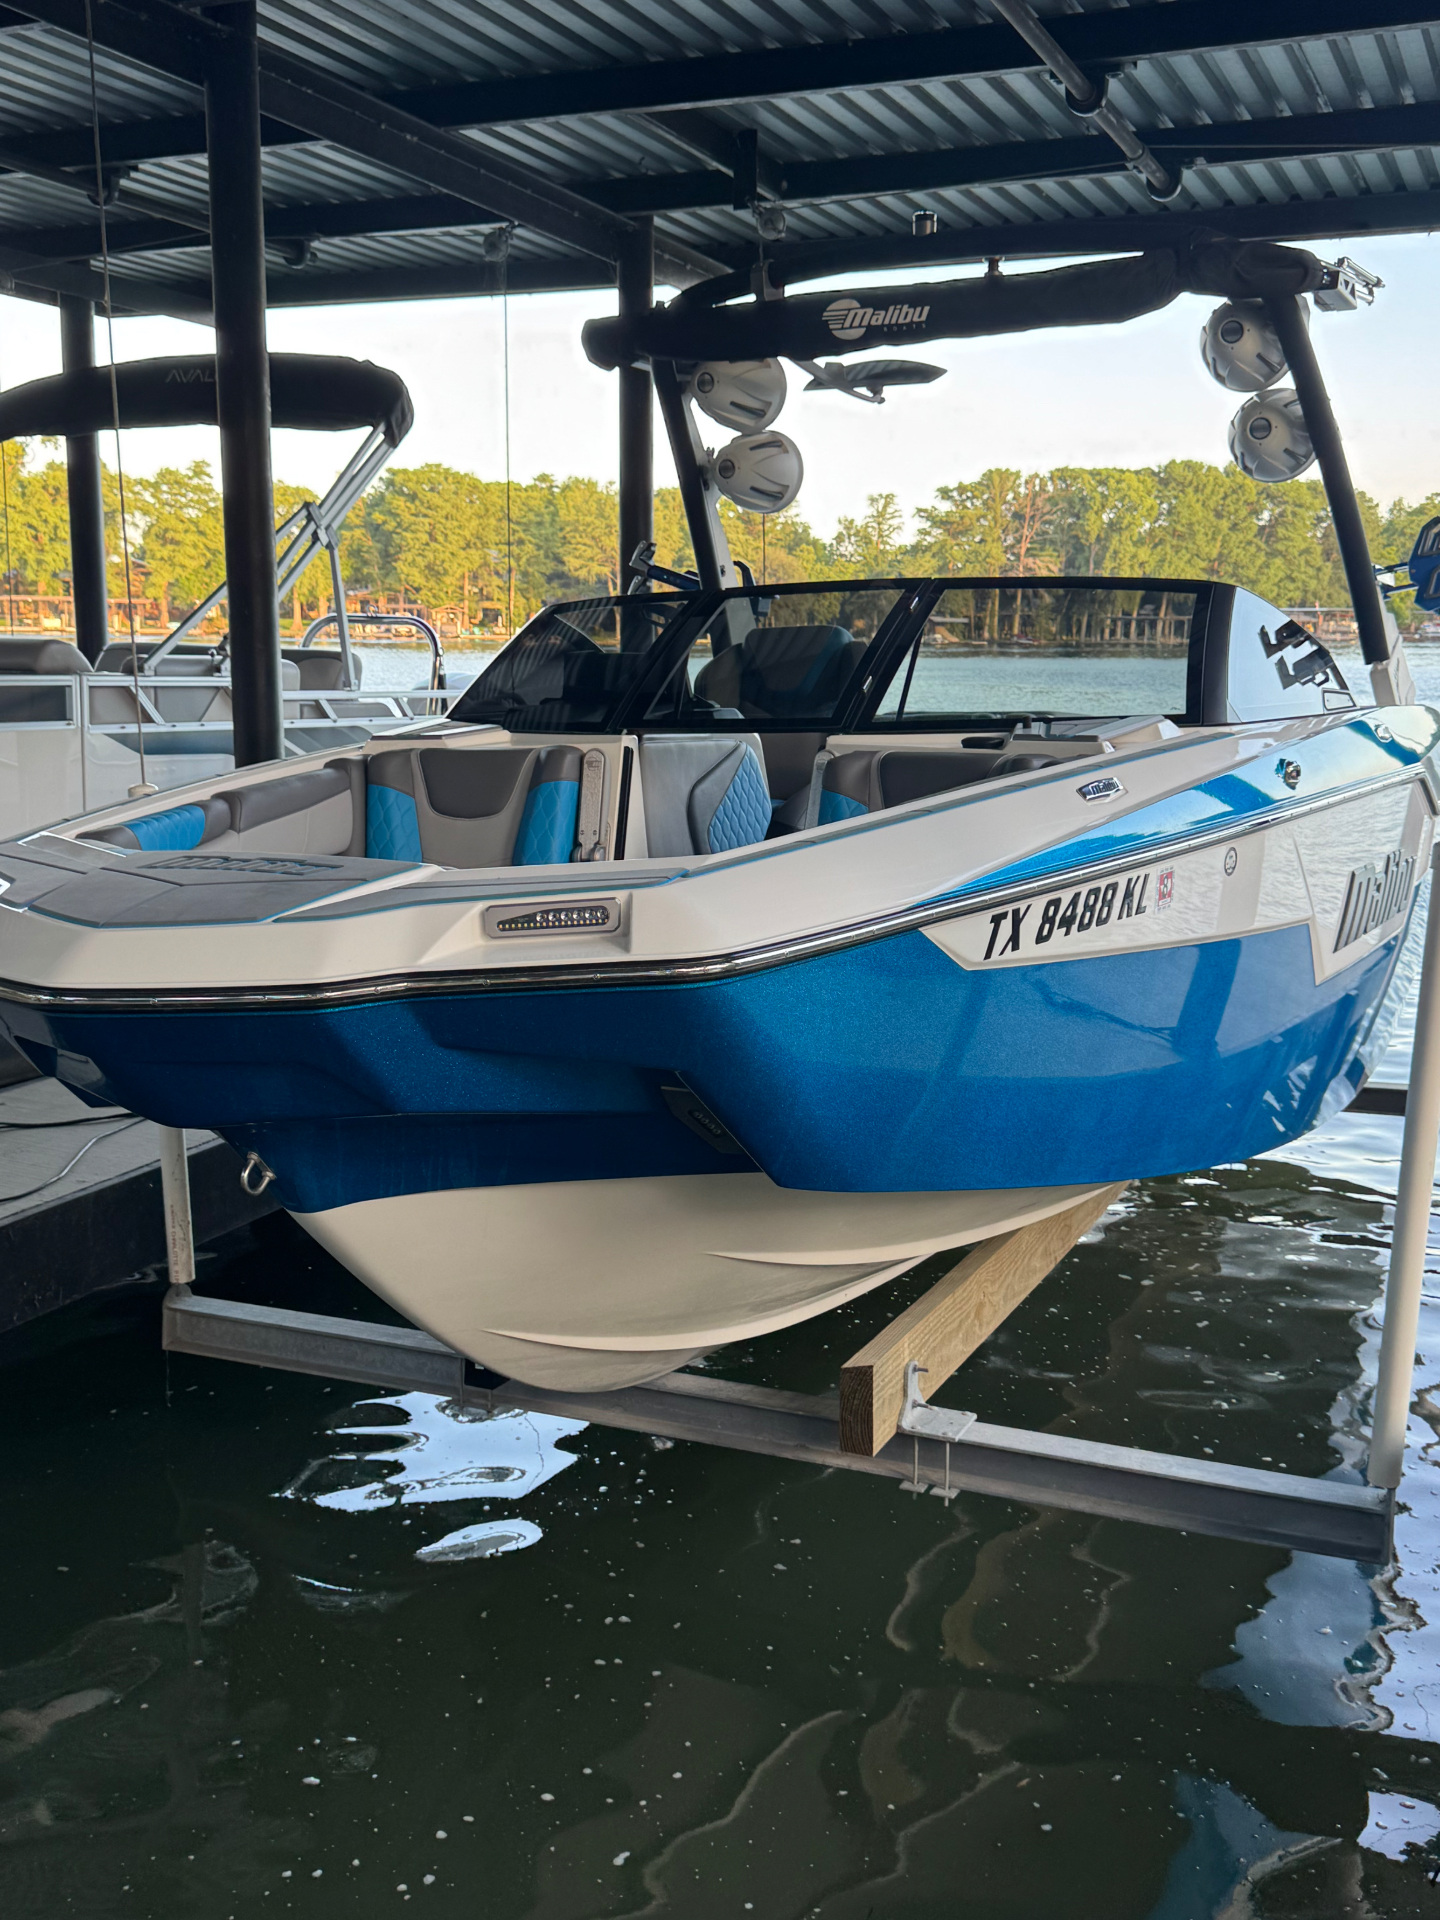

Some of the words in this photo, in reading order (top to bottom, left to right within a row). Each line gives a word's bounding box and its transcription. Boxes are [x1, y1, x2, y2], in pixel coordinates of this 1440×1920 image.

[843, 304, 930, 329] Malibu
[884, 323, 926, 332] BOATS
[165, 368, 216, 383] AVAL
[983, 904, 1032, 960] TX
[1035, 881, 1119, 945] 8488
[1117, 872, 1150, 920] KL
